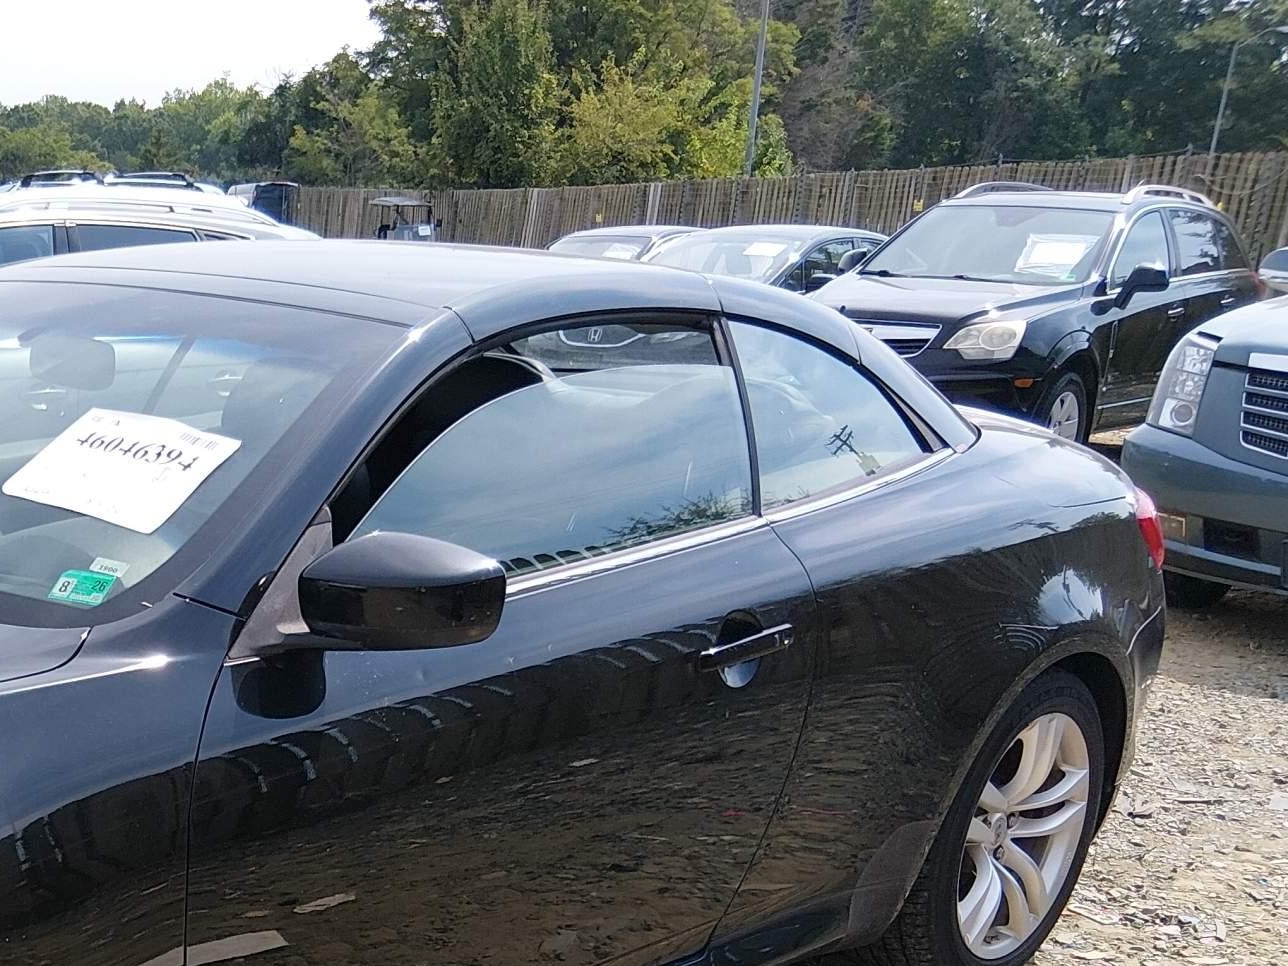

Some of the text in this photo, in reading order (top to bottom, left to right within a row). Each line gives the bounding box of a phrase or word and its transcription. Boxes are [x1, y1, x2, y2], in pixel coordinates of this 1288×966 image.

[76, 431, 200, 472] 46046394
[58, 579, 109, 593] 8 26
